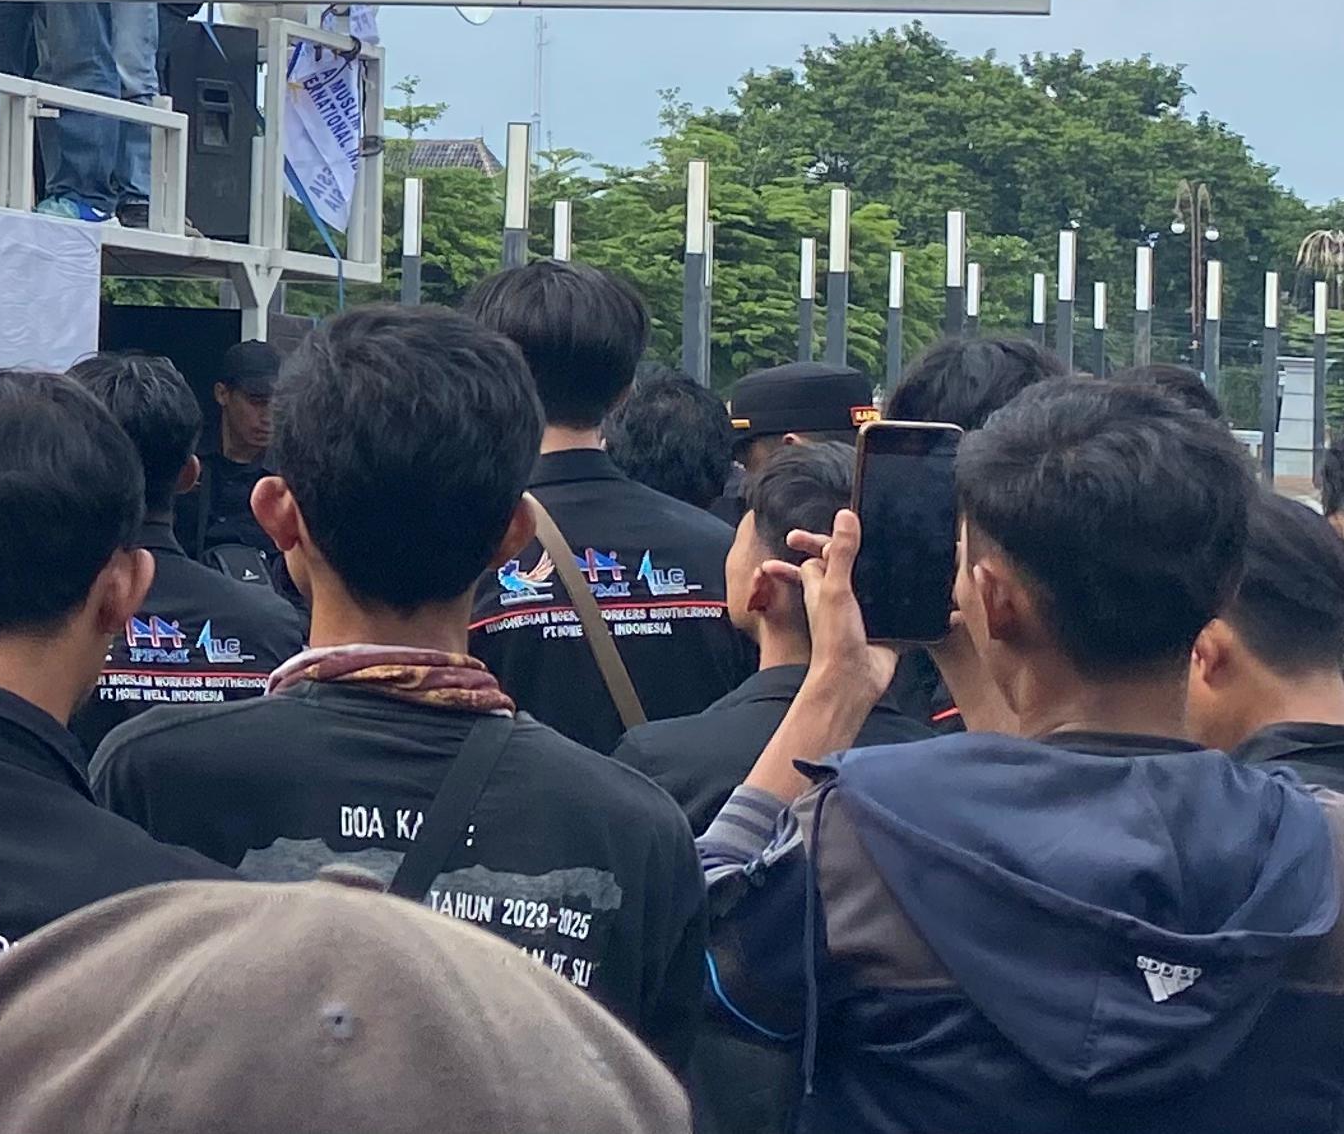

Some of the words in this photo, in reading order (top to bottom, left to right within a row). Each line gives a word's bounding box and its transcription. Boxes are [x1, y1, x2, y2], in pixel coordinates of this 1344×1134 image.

[649, 607, 723, 619] BROTHERHOOD
[614, 622, 673, 636] INDONESIA
[129, 648, 190, 663] PPMI
[205, 677, 268, 689] BROTHERHOO
[171, 690, 224, 702] INDONESIA
[341, 805, 385, 840] DOA
[430, 890, 494, 923] TAHUN
